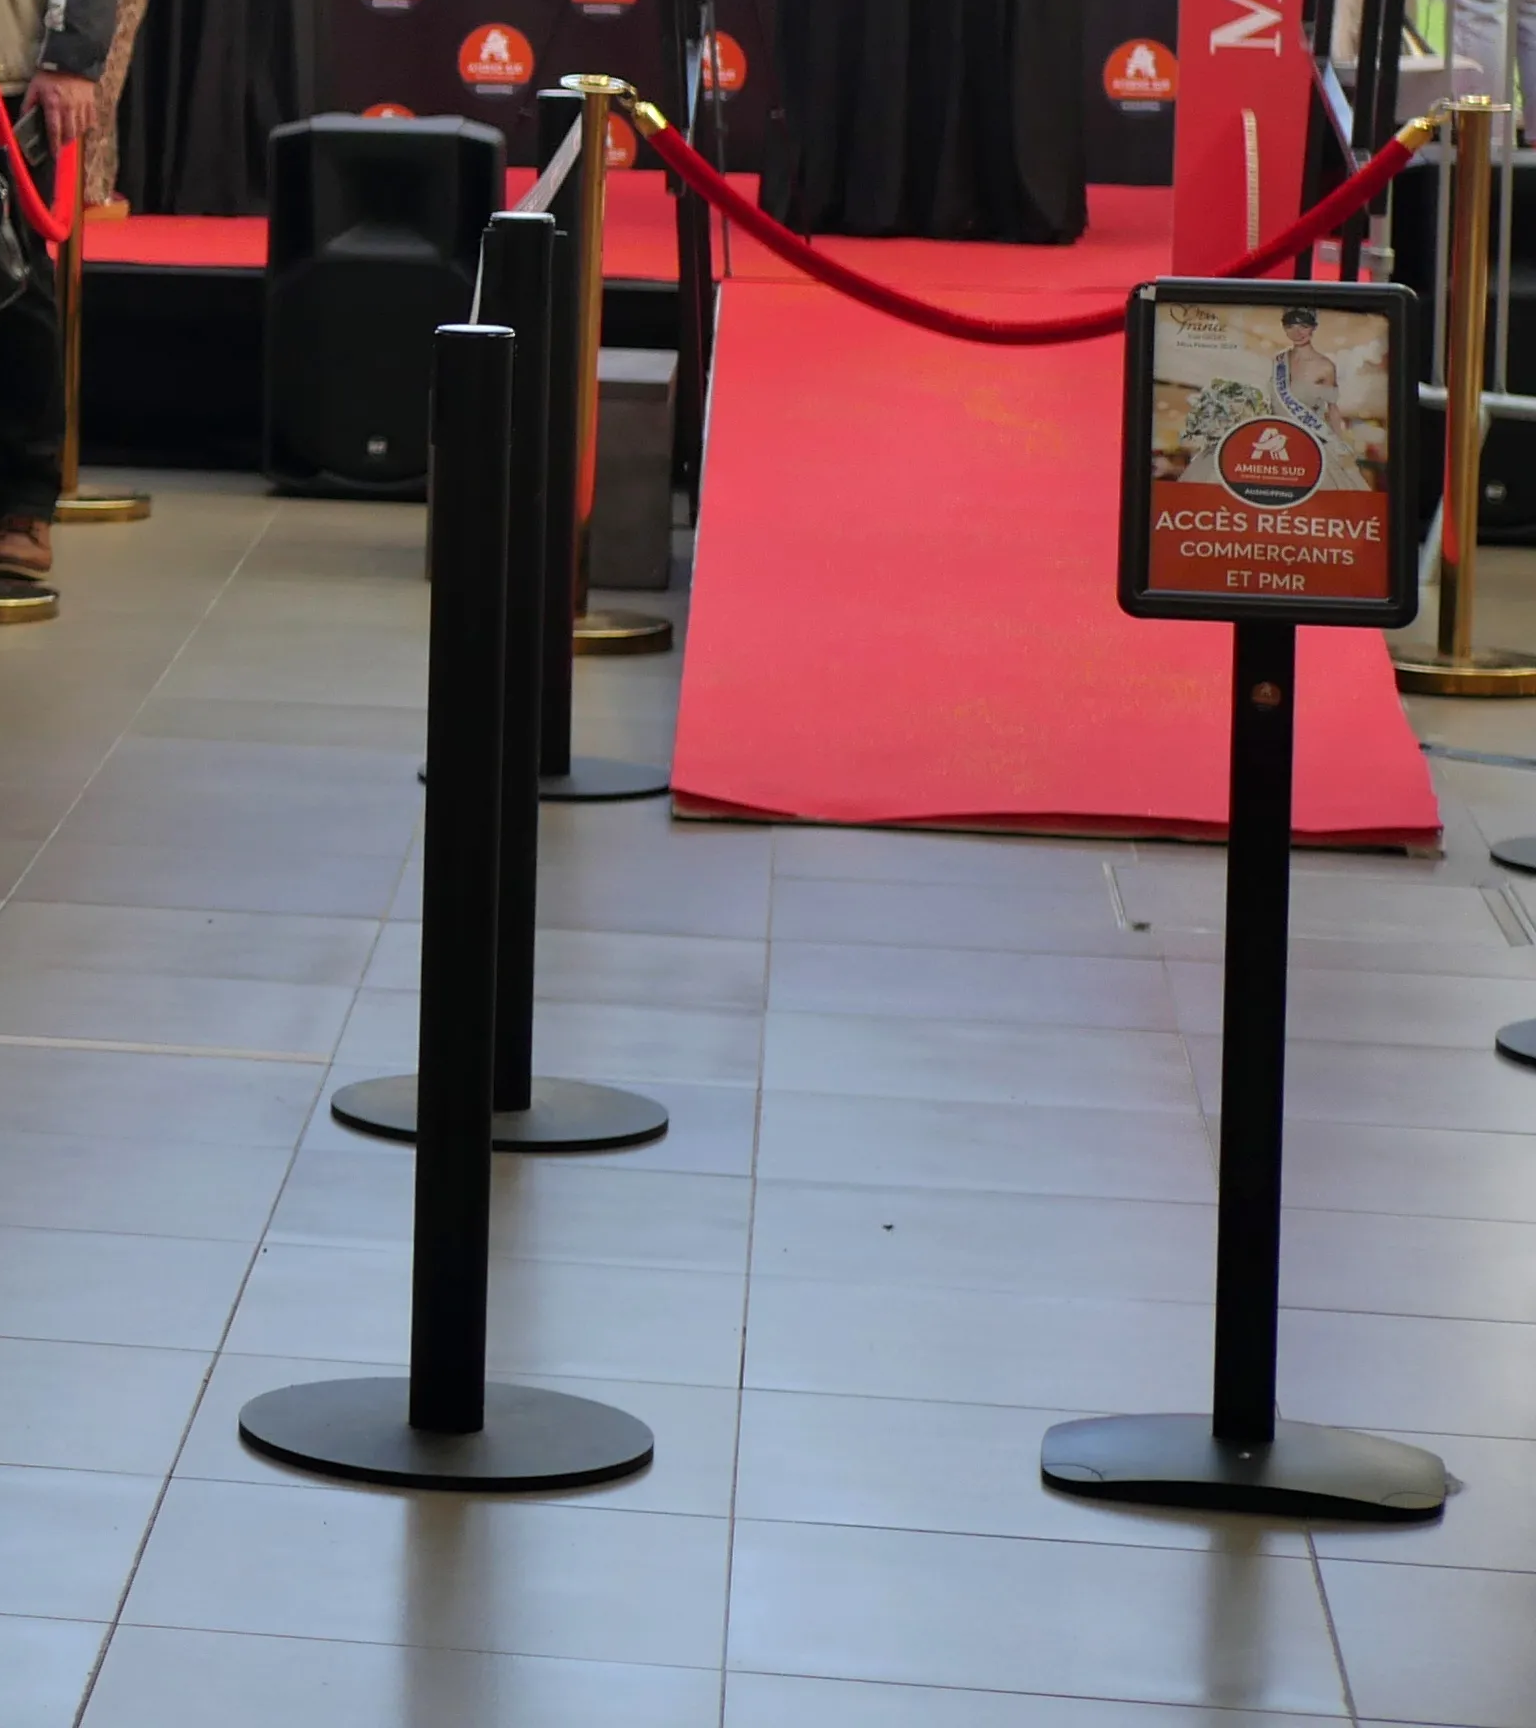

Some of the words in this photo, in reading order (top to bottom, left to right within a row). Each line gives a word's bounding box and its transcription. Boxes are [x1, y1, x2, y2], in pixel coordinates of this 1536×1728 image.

[1234, 463, 1280, 475] AMIENS
[1281, 465, 1306, 477] SUD
[1155, 506, 1248, 532] ACCÈS
[1257, 510, 1381, 542] RÉSERVÉ
[1180, 541, 1354, 566] COMMERÇANTS
[1226, 570, 1252, 588] ET
[1259, 572, 1306, 591] PMR
